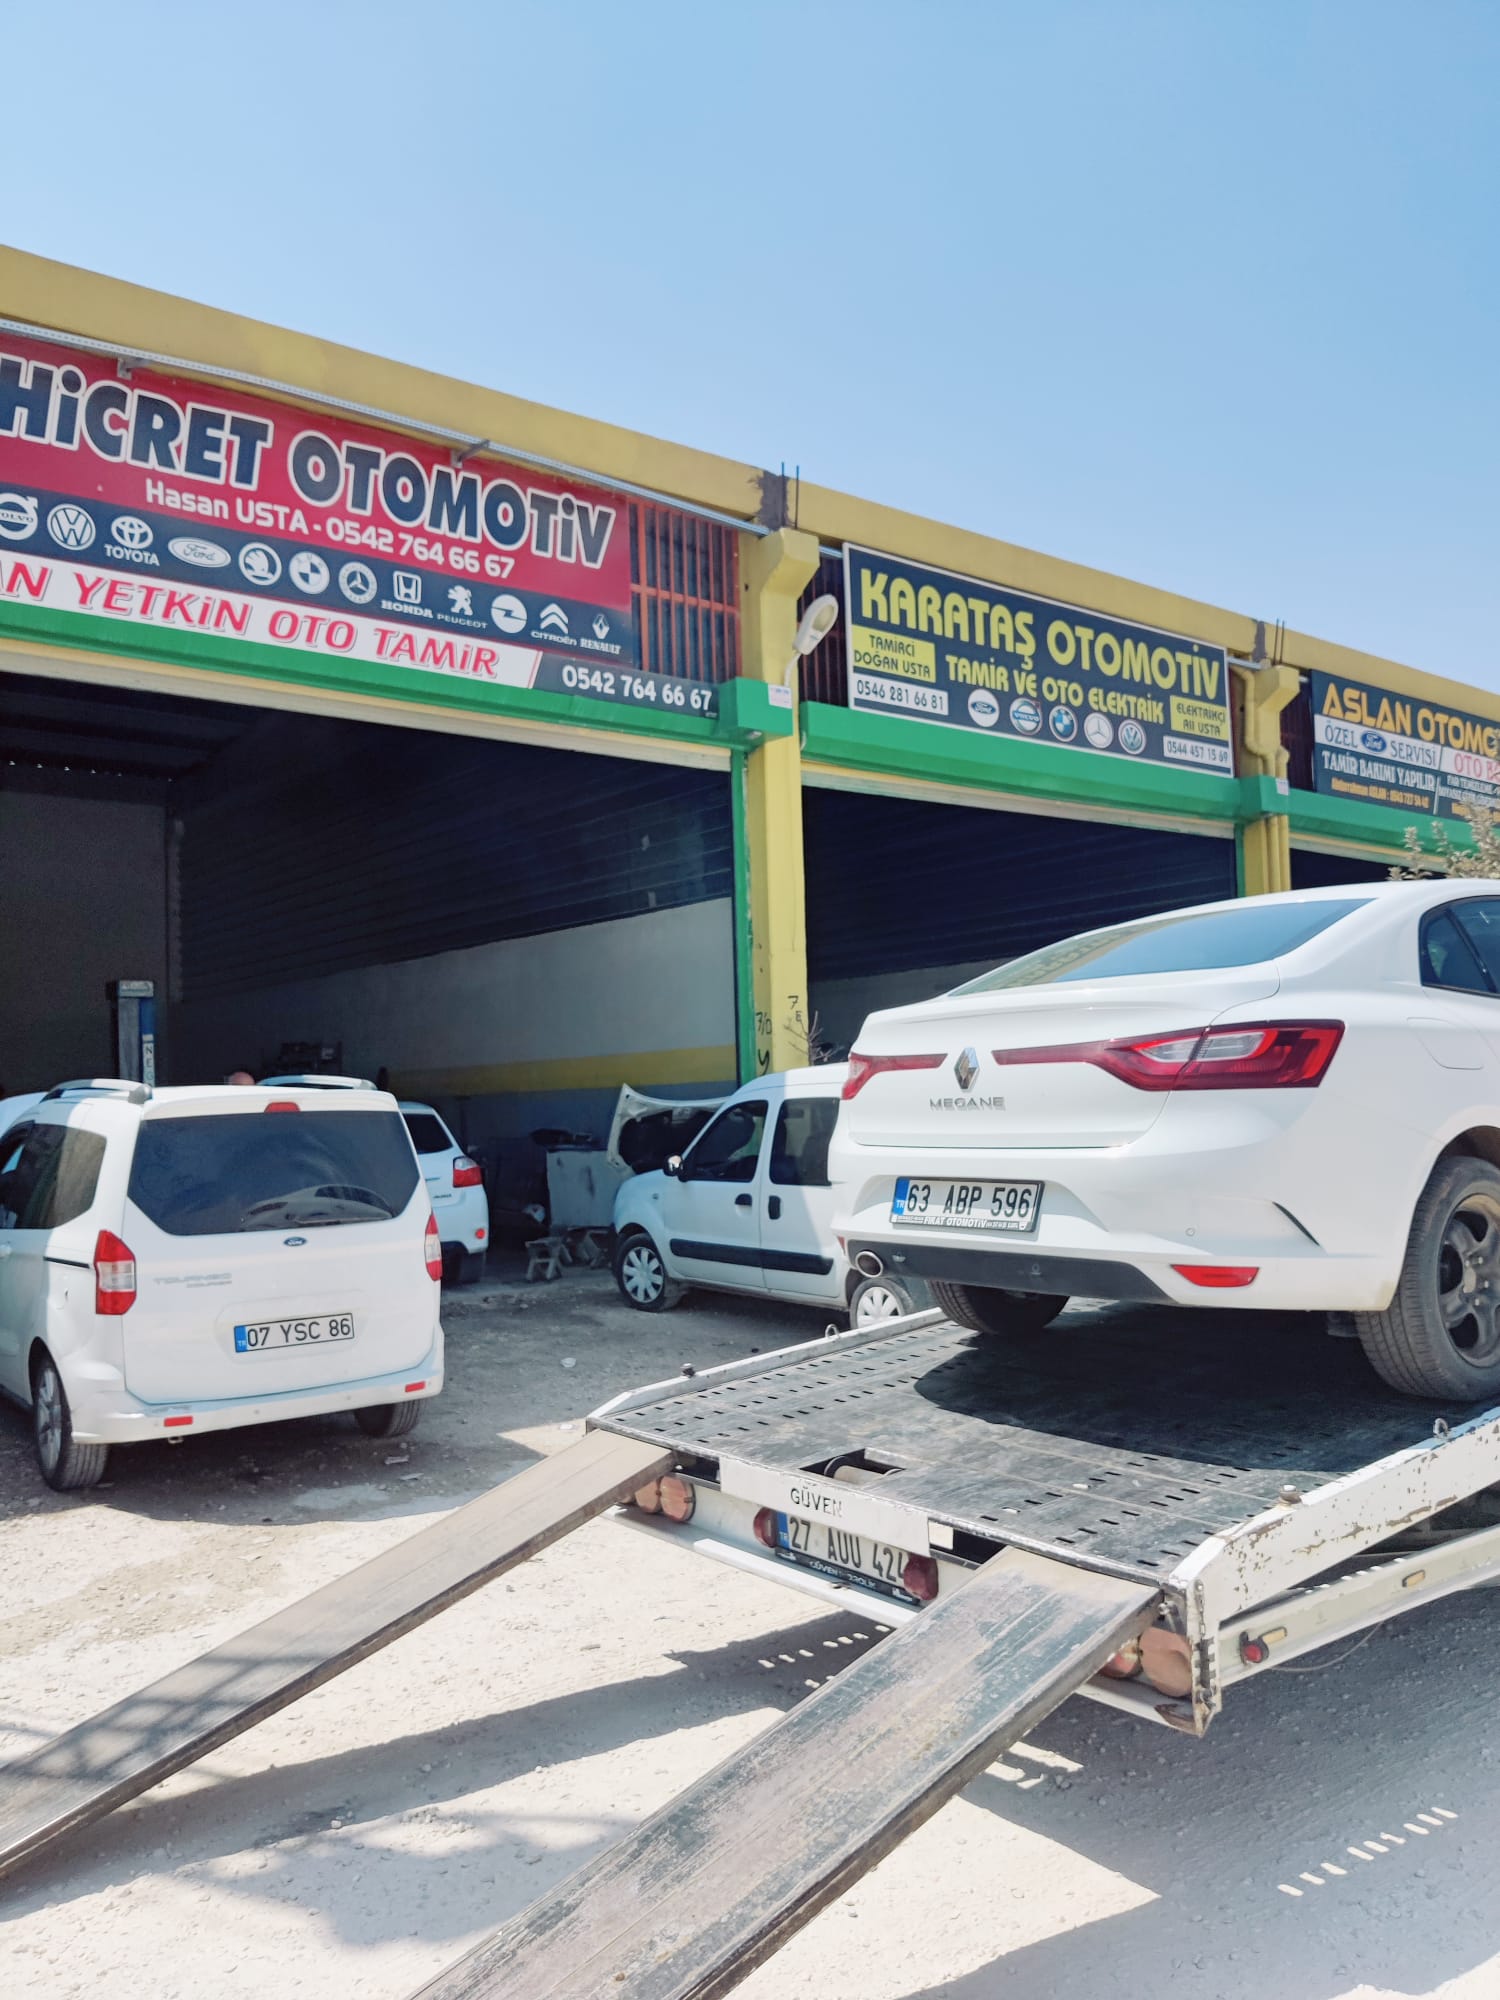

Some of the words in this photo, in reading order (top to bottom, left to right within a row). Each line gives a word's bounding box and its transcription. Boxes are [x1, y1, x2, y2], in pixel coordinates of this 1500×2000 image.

[288, 430, 616, 569] OTOMOTiV
[146, 478, 229, 519] Hasan
[237, 500, 310, 535] USTA
[326, 516, 394, 553] 0542
[398, 533, 444, 565] 764
[449, 546, 480, 573] 66
[485, 555, 514, 579] 67
[104, 543, 160, 567] TOYOTA
[183, 544, 216, 561] Ford
[73, 571, 252, 634] YETKiN
[268, 609, 358, 649] OTO
[374, 627, 498, 677] TAMiR
[381, 600, 433, 619] HONDA
[437, 613, 488, 629] PEUGEOT
[580, 638, 622, 655] RENAULT
[860, 568, 1036, 670] KARATAŞ
[1047, 620, 1219, 700] OTOMOTİV
[854, 649, 899, 671] DOĞAN
[903, 661, 931, 679] USTA
[562, 665, 616, 695] 0542
[620, 675, 657, 701] 764
[662, 683, 685, 706] 66
[690, 689, 712, 710] 67
[857, 679, 886, 698] 0546
[889, 686, 909, 704] 281
[914, 691, 927, 707] 66
[931, 695, 943, 711] 81
[945, 654, 1009, 692] TAMİR
[1013, 669, 1038, 698] VE
[1042, 676, 1084, 707] OTO
[1088, 687, 1164, 724] ELEKTRİK
[1322, 682, 1412, 736] ASLAN
[1198, 722, 1221, 737] USTA
[1325, 720, 1358, 748] ÖZEL
[1167, 740, 1187, 755] 0544
[1322, 750, 1358, 775] TAMİR
[1454, 753, 1482, 778] OTO
[930, 1097, 1005, 1110] MEGANE
[907, 1184, 931, 1212] 63
[943, 1185, 982, 1215] ABP
[991, 1187, 1032, 1218] 596
[247, 1327, 270, 1347] 07
[280, 1322, 320, 1343] YSC
[329, 1318, 350, 1337] 86
[790, 1485, 843, 1517] GÜVEN
[790, 1516, 811, 1551] 27
[827, 1528, 862, 1568] AUU
